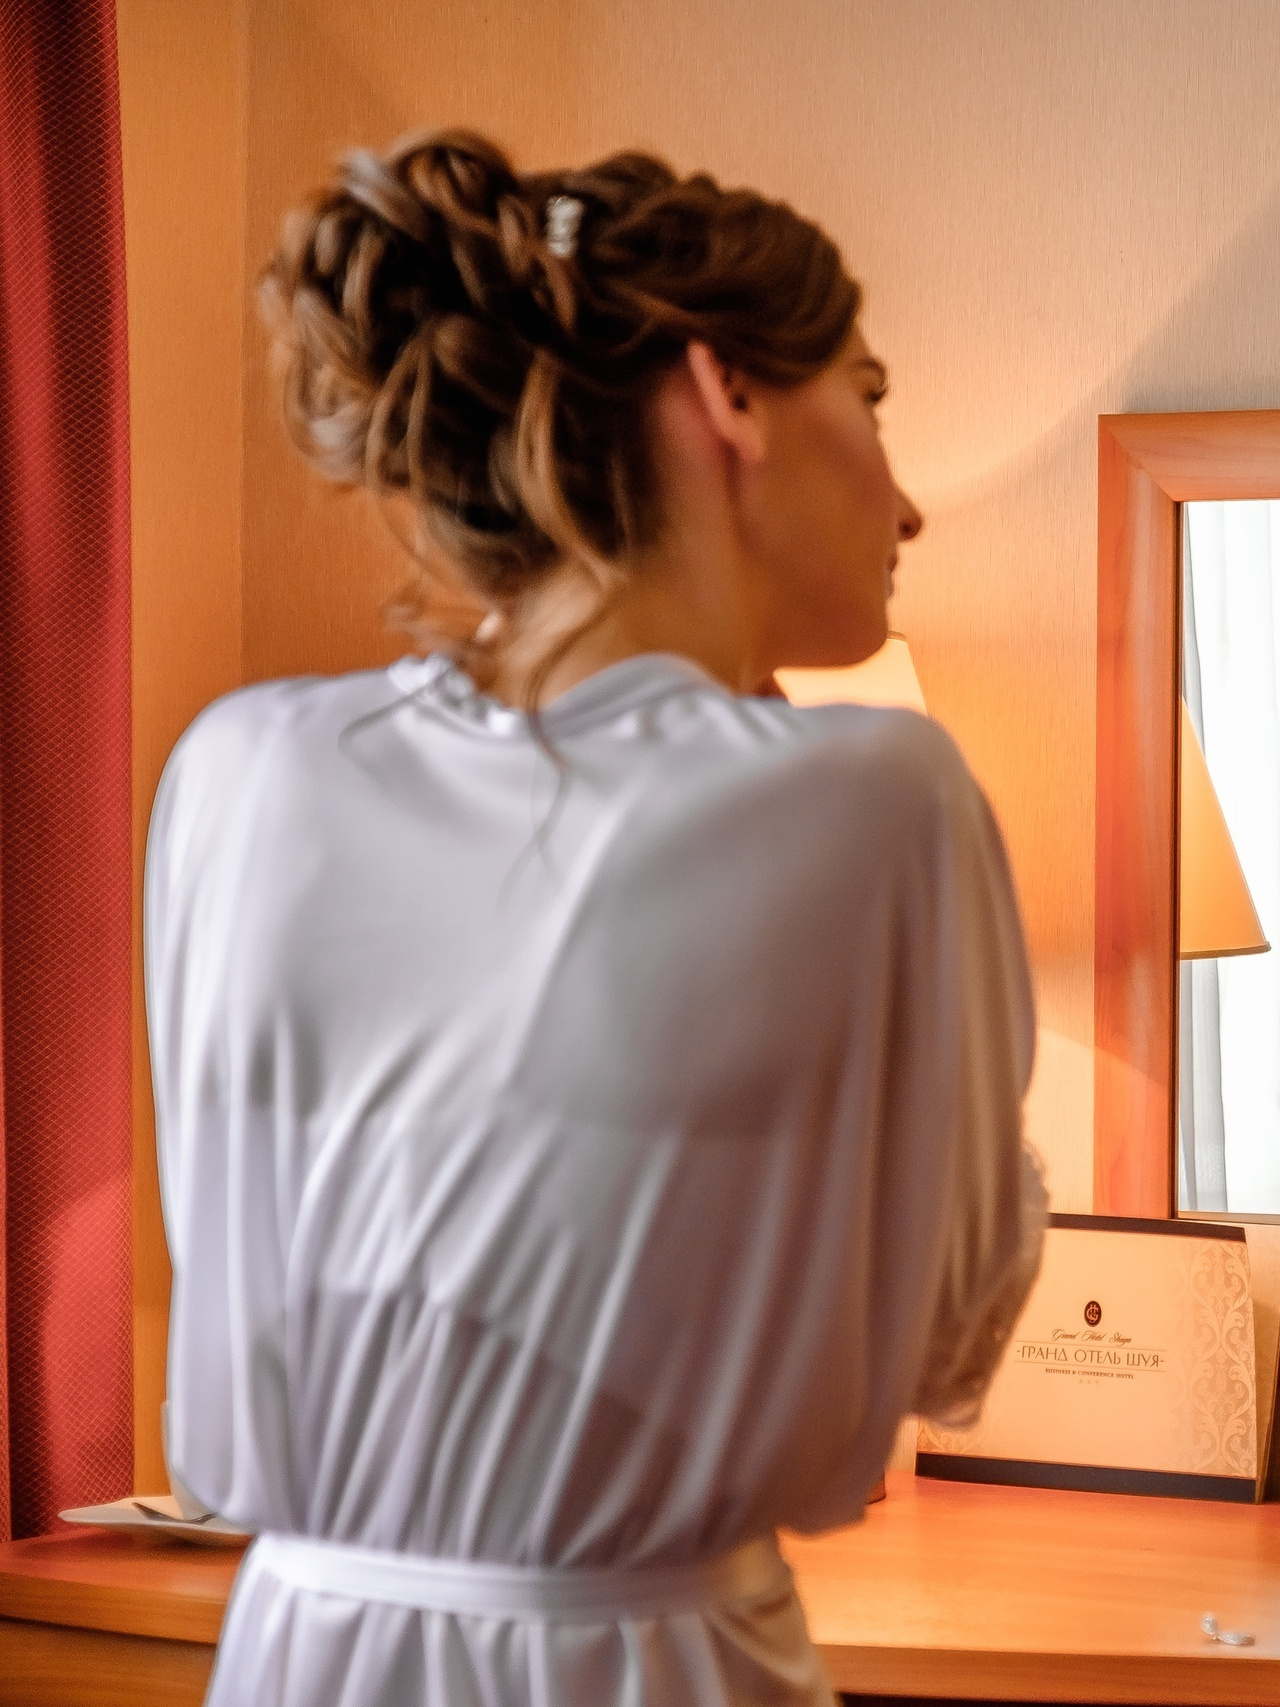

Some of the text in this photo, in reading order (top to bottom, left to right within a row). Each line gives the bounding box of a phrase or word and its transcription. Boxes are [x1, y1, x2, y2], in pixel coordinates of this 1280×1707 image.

[1051, 1329, 1080, 1341] Grand
[1081, 1330, 1106, 1342] Hotel
[1074, 1349, 1121, 1365] ОТЕЛЬ
[1078, 1370, 1114, 1378] CONFERENCE
